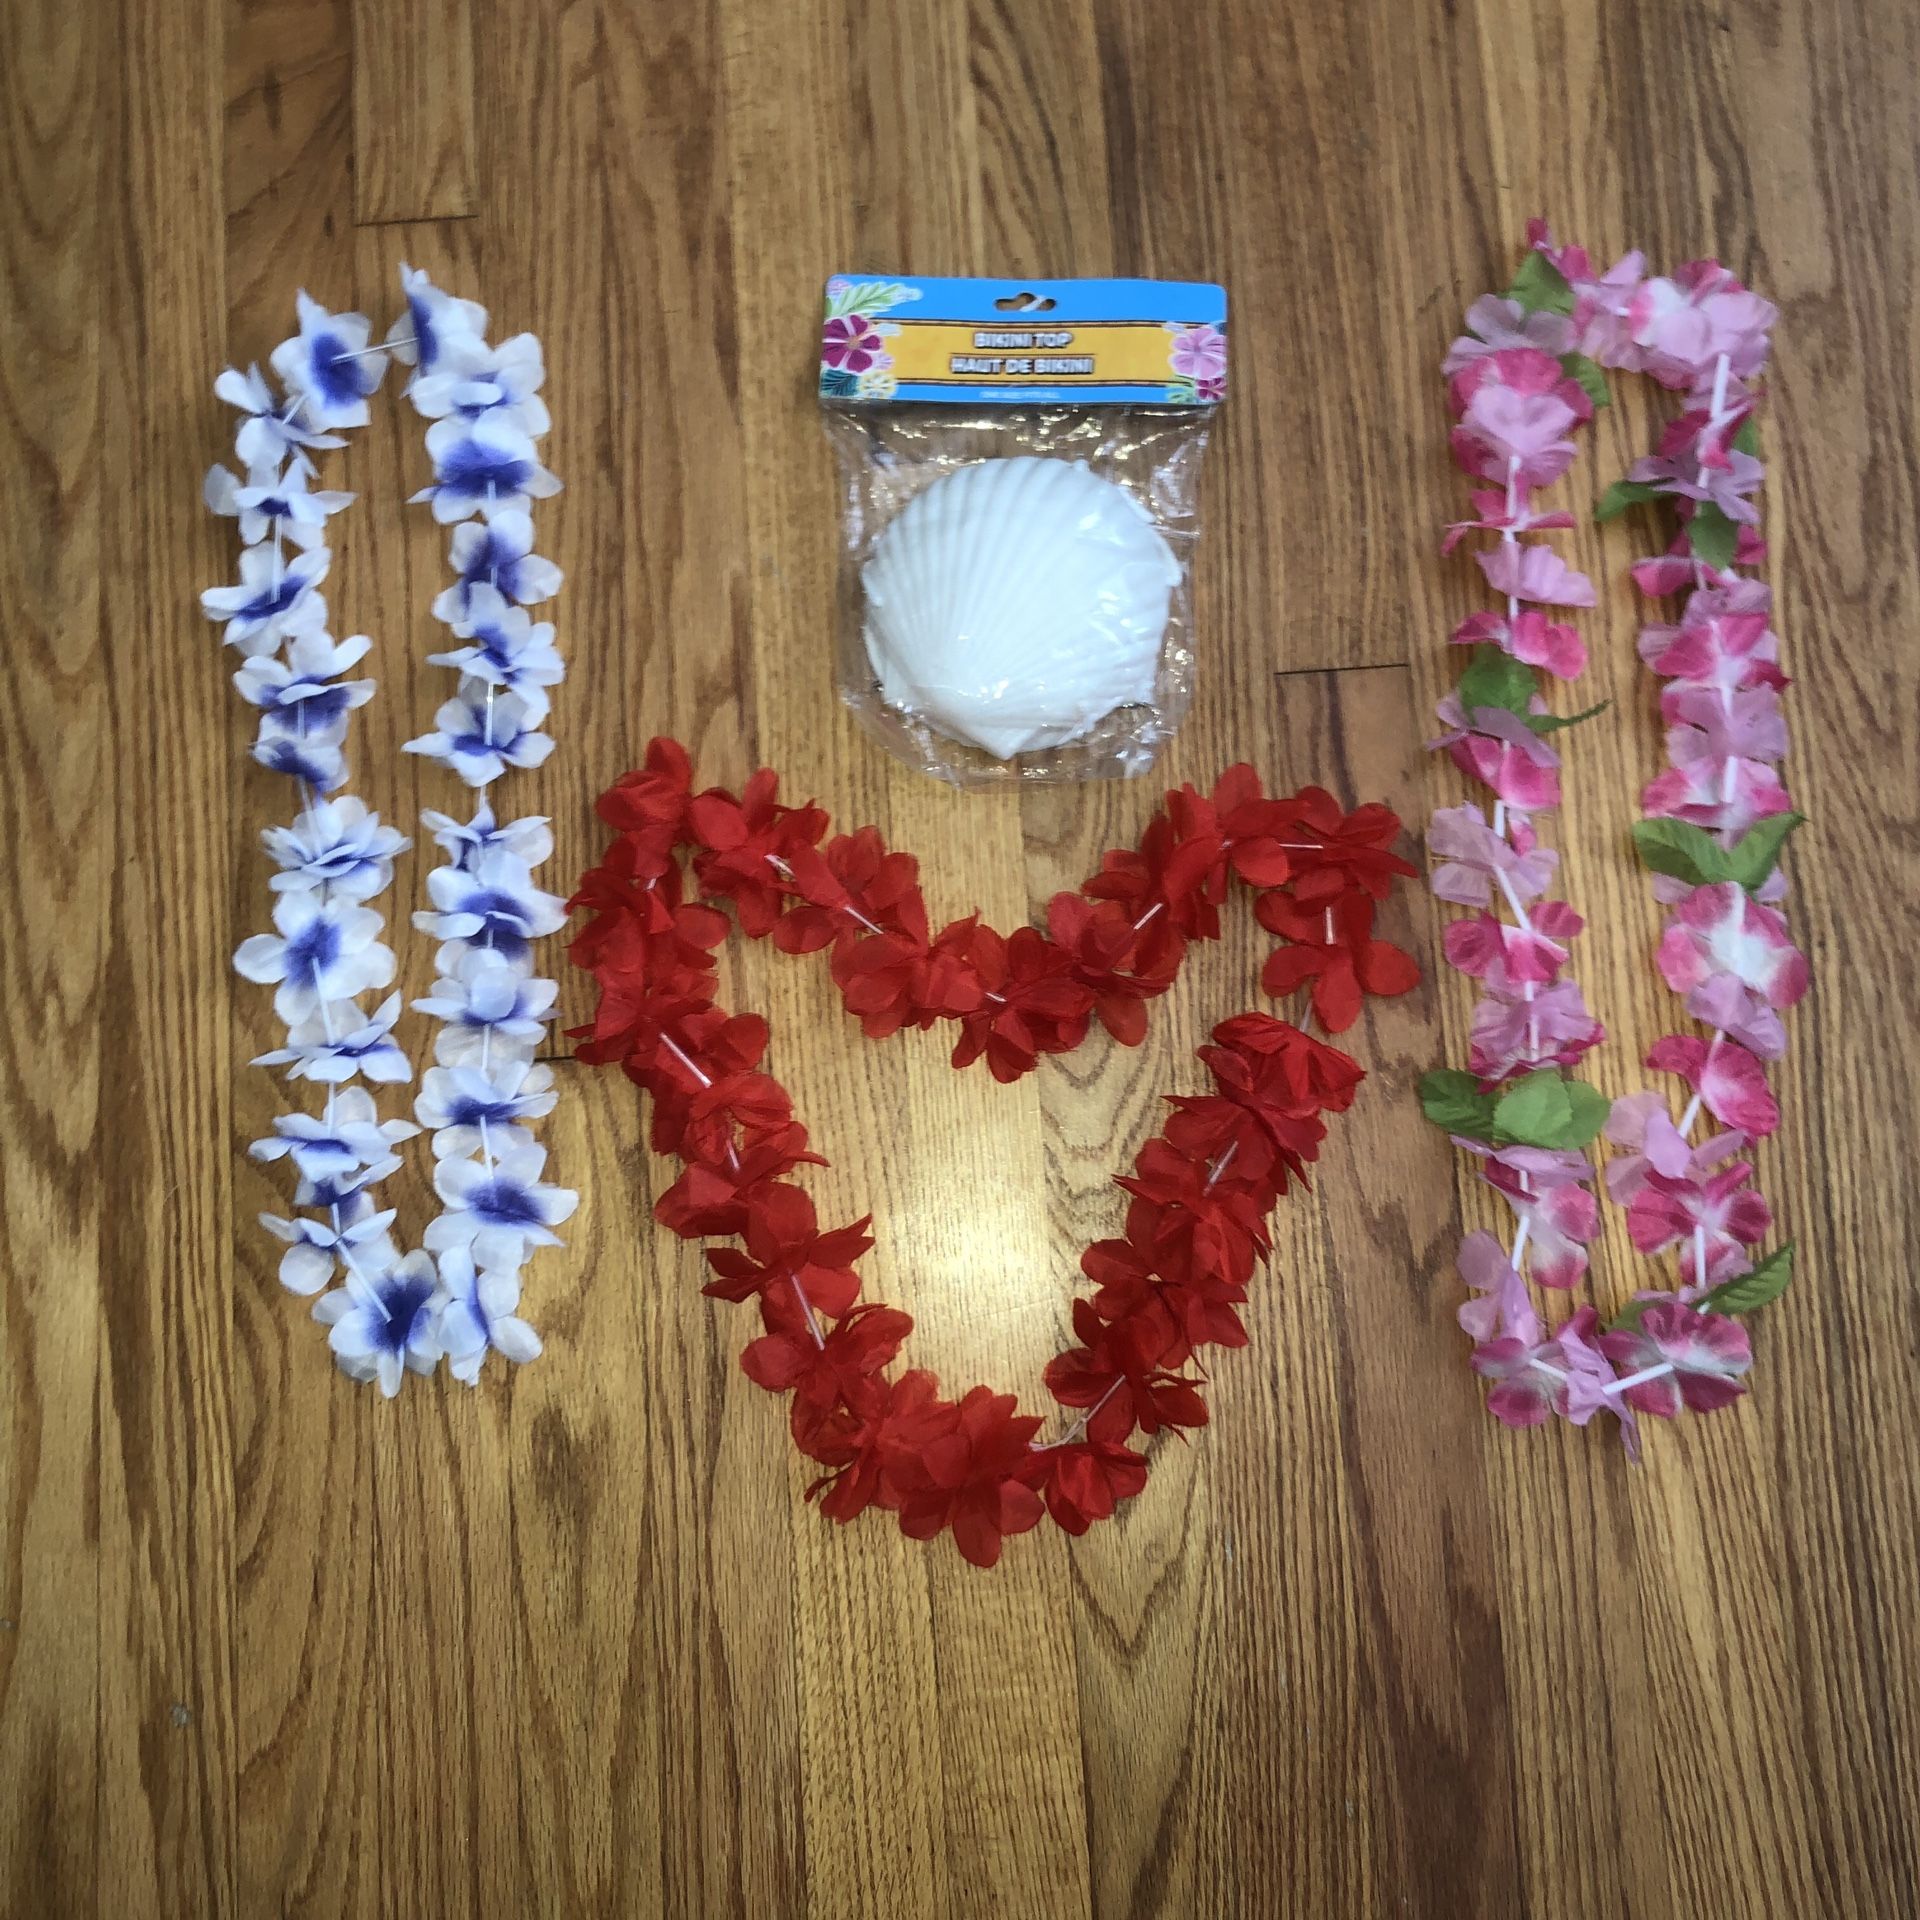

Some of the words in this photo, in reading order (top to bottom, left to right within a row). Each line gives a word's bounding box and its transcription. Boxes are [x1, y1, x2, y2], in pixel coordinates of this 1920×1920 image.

[974, 332, 1033, 348] BIKINI
[1033, 332, 1073, 348] TOP
[951, 357, 1002, 373] HAUT
[1005, 357, 1034, 374] DE
[1034, 358, 1094, 374] BIKINI
